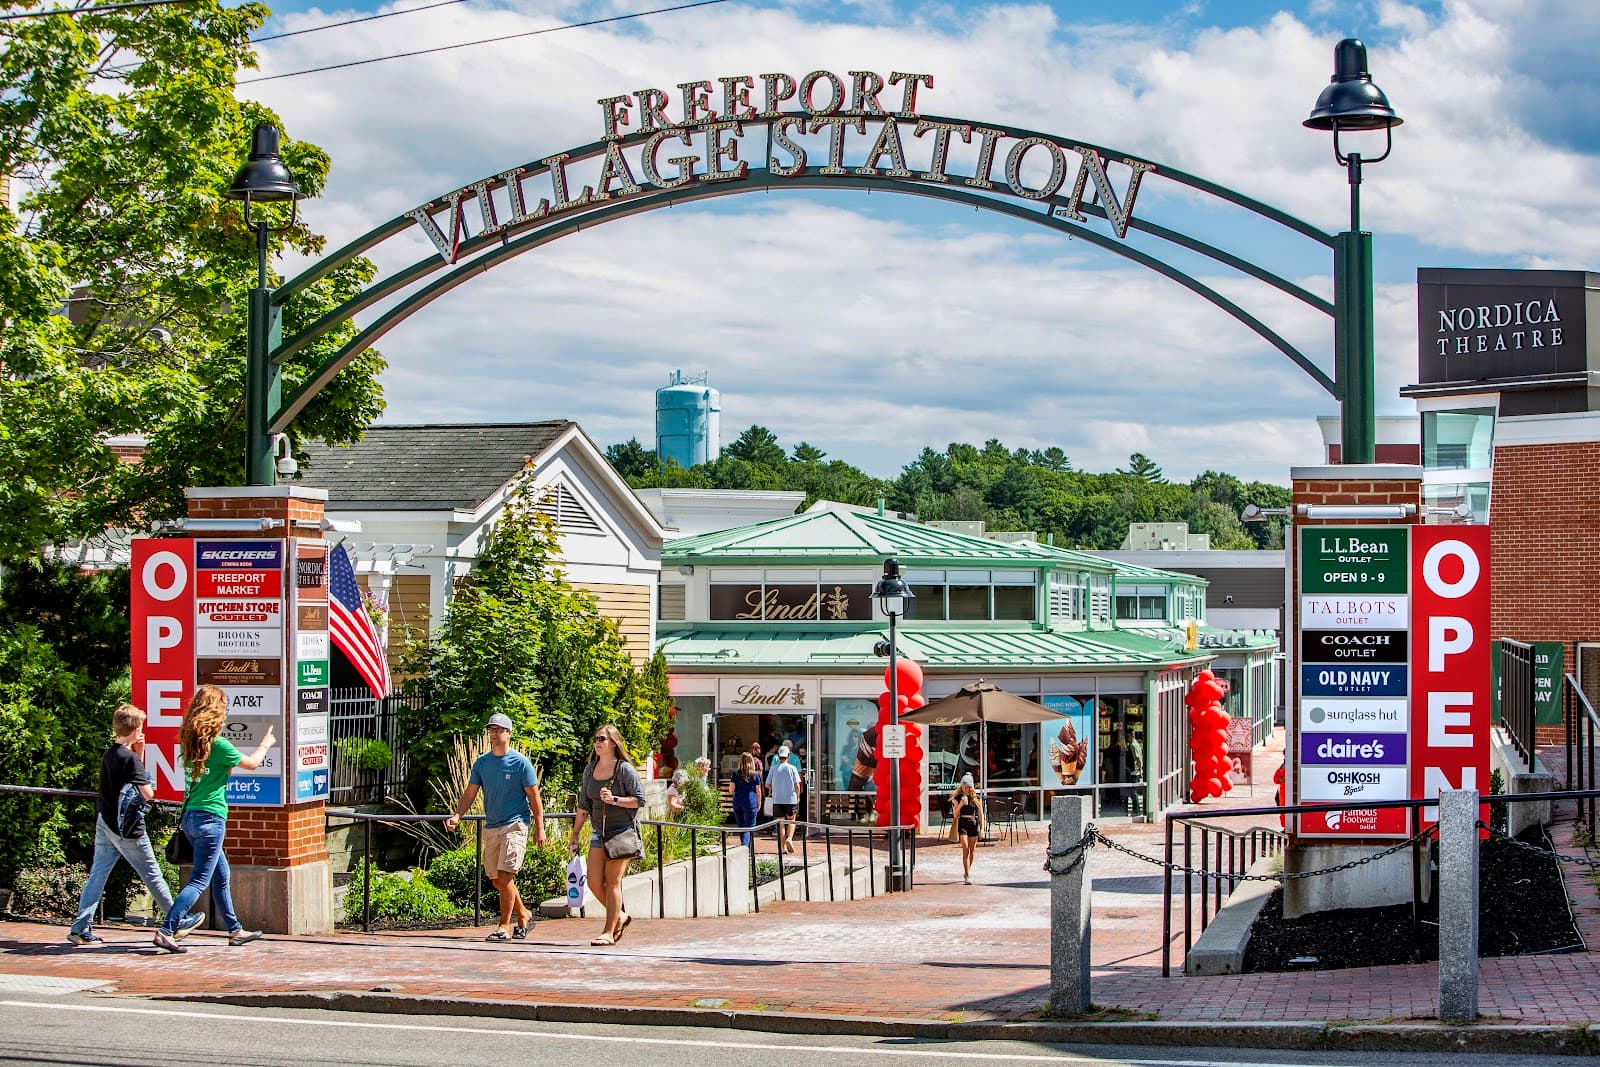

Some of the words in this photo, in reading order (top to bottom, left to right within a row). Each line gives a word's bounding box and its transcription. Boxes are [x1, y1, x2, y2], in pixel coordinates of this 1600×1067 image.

[597, 70, 934, 141] FREEPORT
[405, 121, 747, 264] VILLAGE
[770, 117, 1155, 238] STATION
[1438, 299, 1560, 333] NORDICA
[1437, 328, 1563, 356] THEATRE
[1320, 537, 1389, 553] L.L.Bean
[200, 550, 278, 560] SKECHERS
[1338, 555, 1372, 563] OUTLET
[211, 573, 267, 583] FREEPORT
[1323, 572, 1358, 583] OPEN
[1360, 572, 1368, 583] 9
[1377, 572, 1385, 583] 9
[216, 585, 260, 595] MARKET
[198, 602, 244, 614] KITCHEN
[245, 602, 279, 614] STORE
[735, 588, 827, 620] Lindt
[1308, 601, 1396, 615] TALBOTS
[1336, 617, 1369, 625] OUTLET
[218, 631, 261, 640] BROOKS
[1320, 635, 1391, 645] COACH
[218, 640, 261, 648] BROTHERS
[1334, 648, 1377, 657] OUTLET
[142, 550, 187, 792] OPEN
[218, 660, 252, 673] Lindt
[1318, 670, 1348, 686] OLD
[1350, 671, 1391, 686] NAVY
[232, 695, 264, 708] AT&T
[301, 690, 323, 700] COACH
[731, 684, 791, 706] Lindt
[1327, 708, 1377, 722] sunglass
[1379, 708, 1399, 720] hut
[1317, 738, 1385, 759] claire's
[226, 779, 261, 792] rter's
[1343, 809, 1378, 817] Famous
